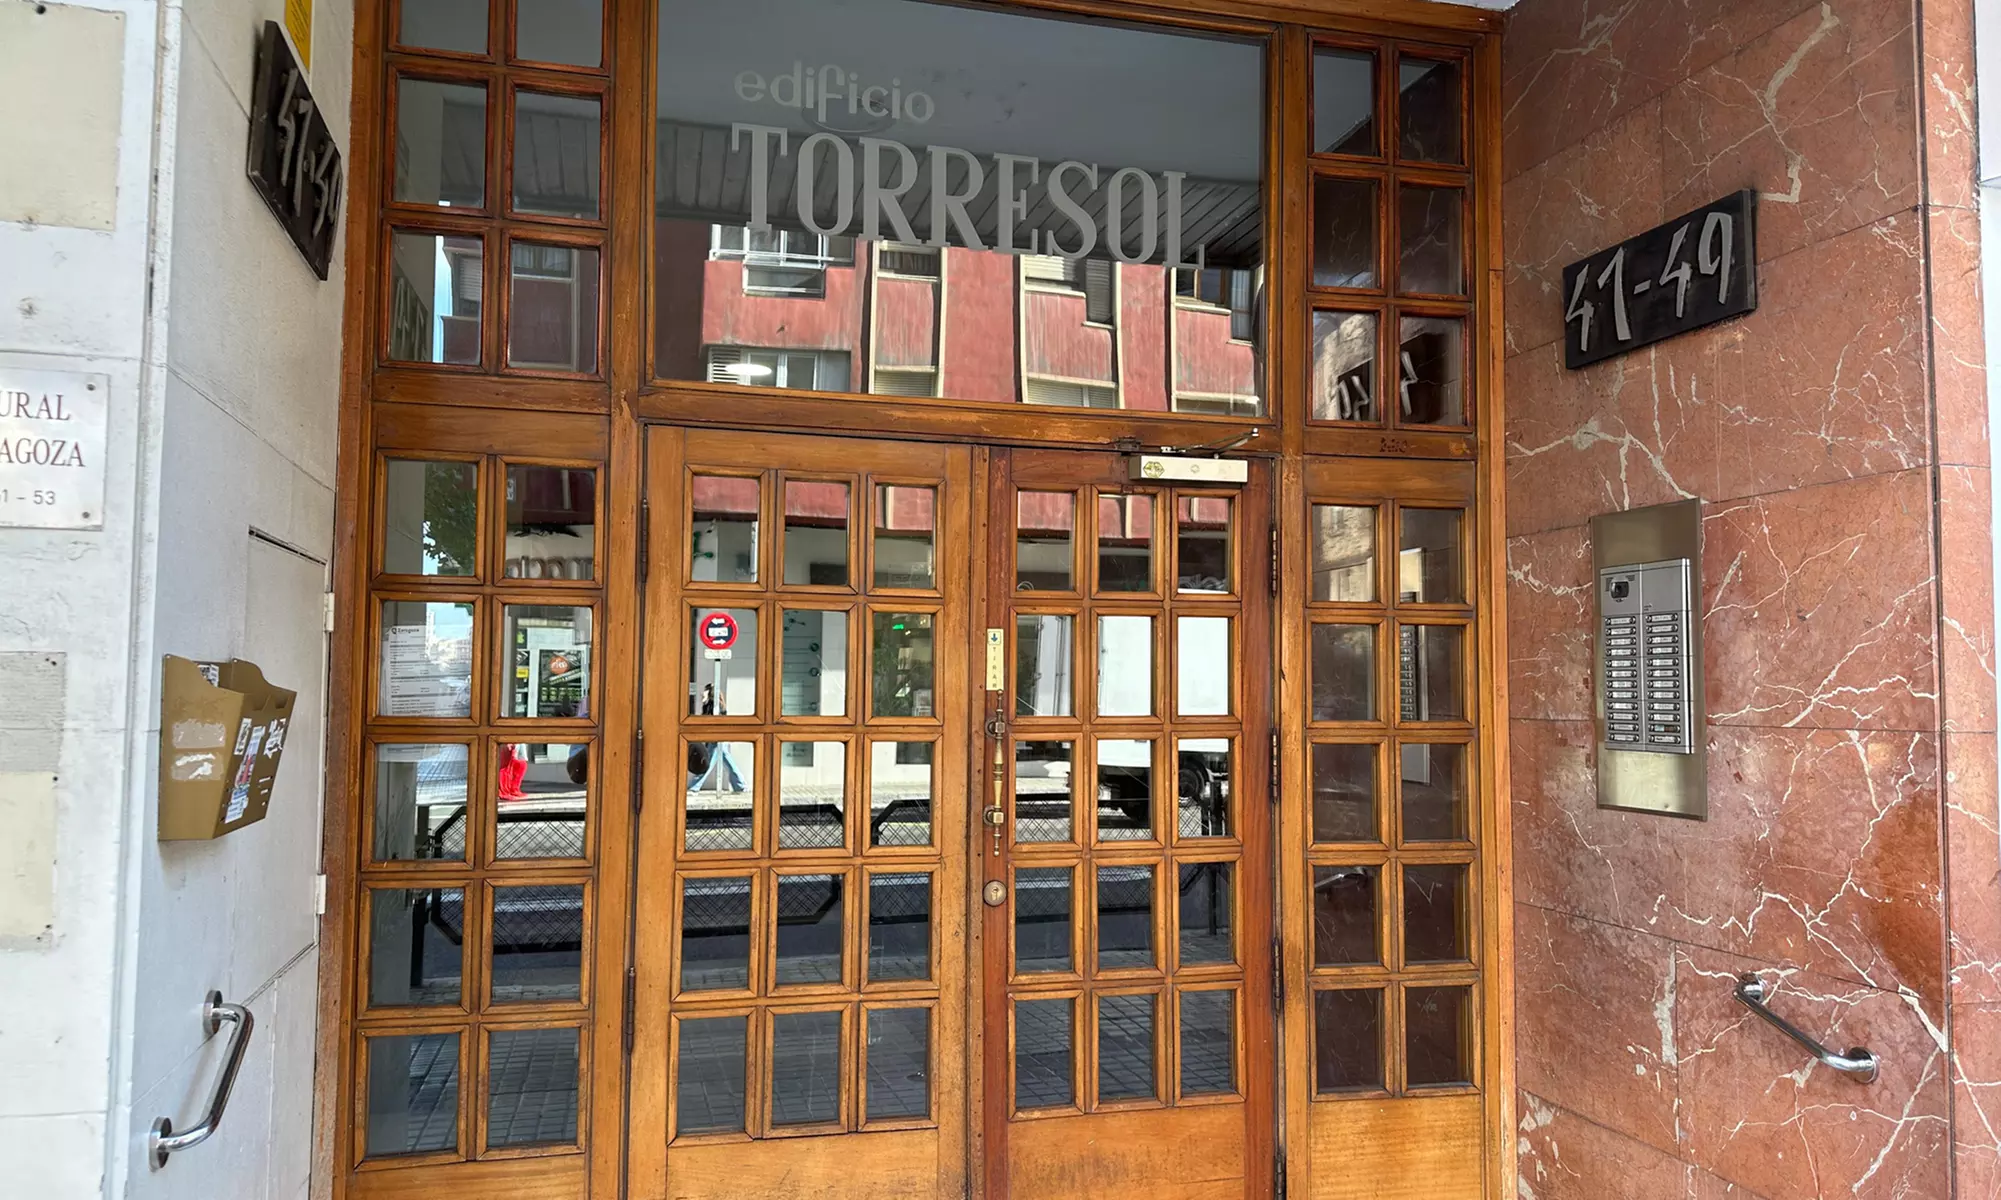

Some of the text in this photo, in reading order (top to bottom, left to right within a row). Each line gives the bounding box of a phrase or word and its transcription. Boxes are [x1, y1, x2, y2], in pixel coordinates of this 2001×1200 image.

[733, 61, 936, 125] edificio
[731, 122, 1205, 270] TORRESOL
[33, 490, 56, 505] 53
